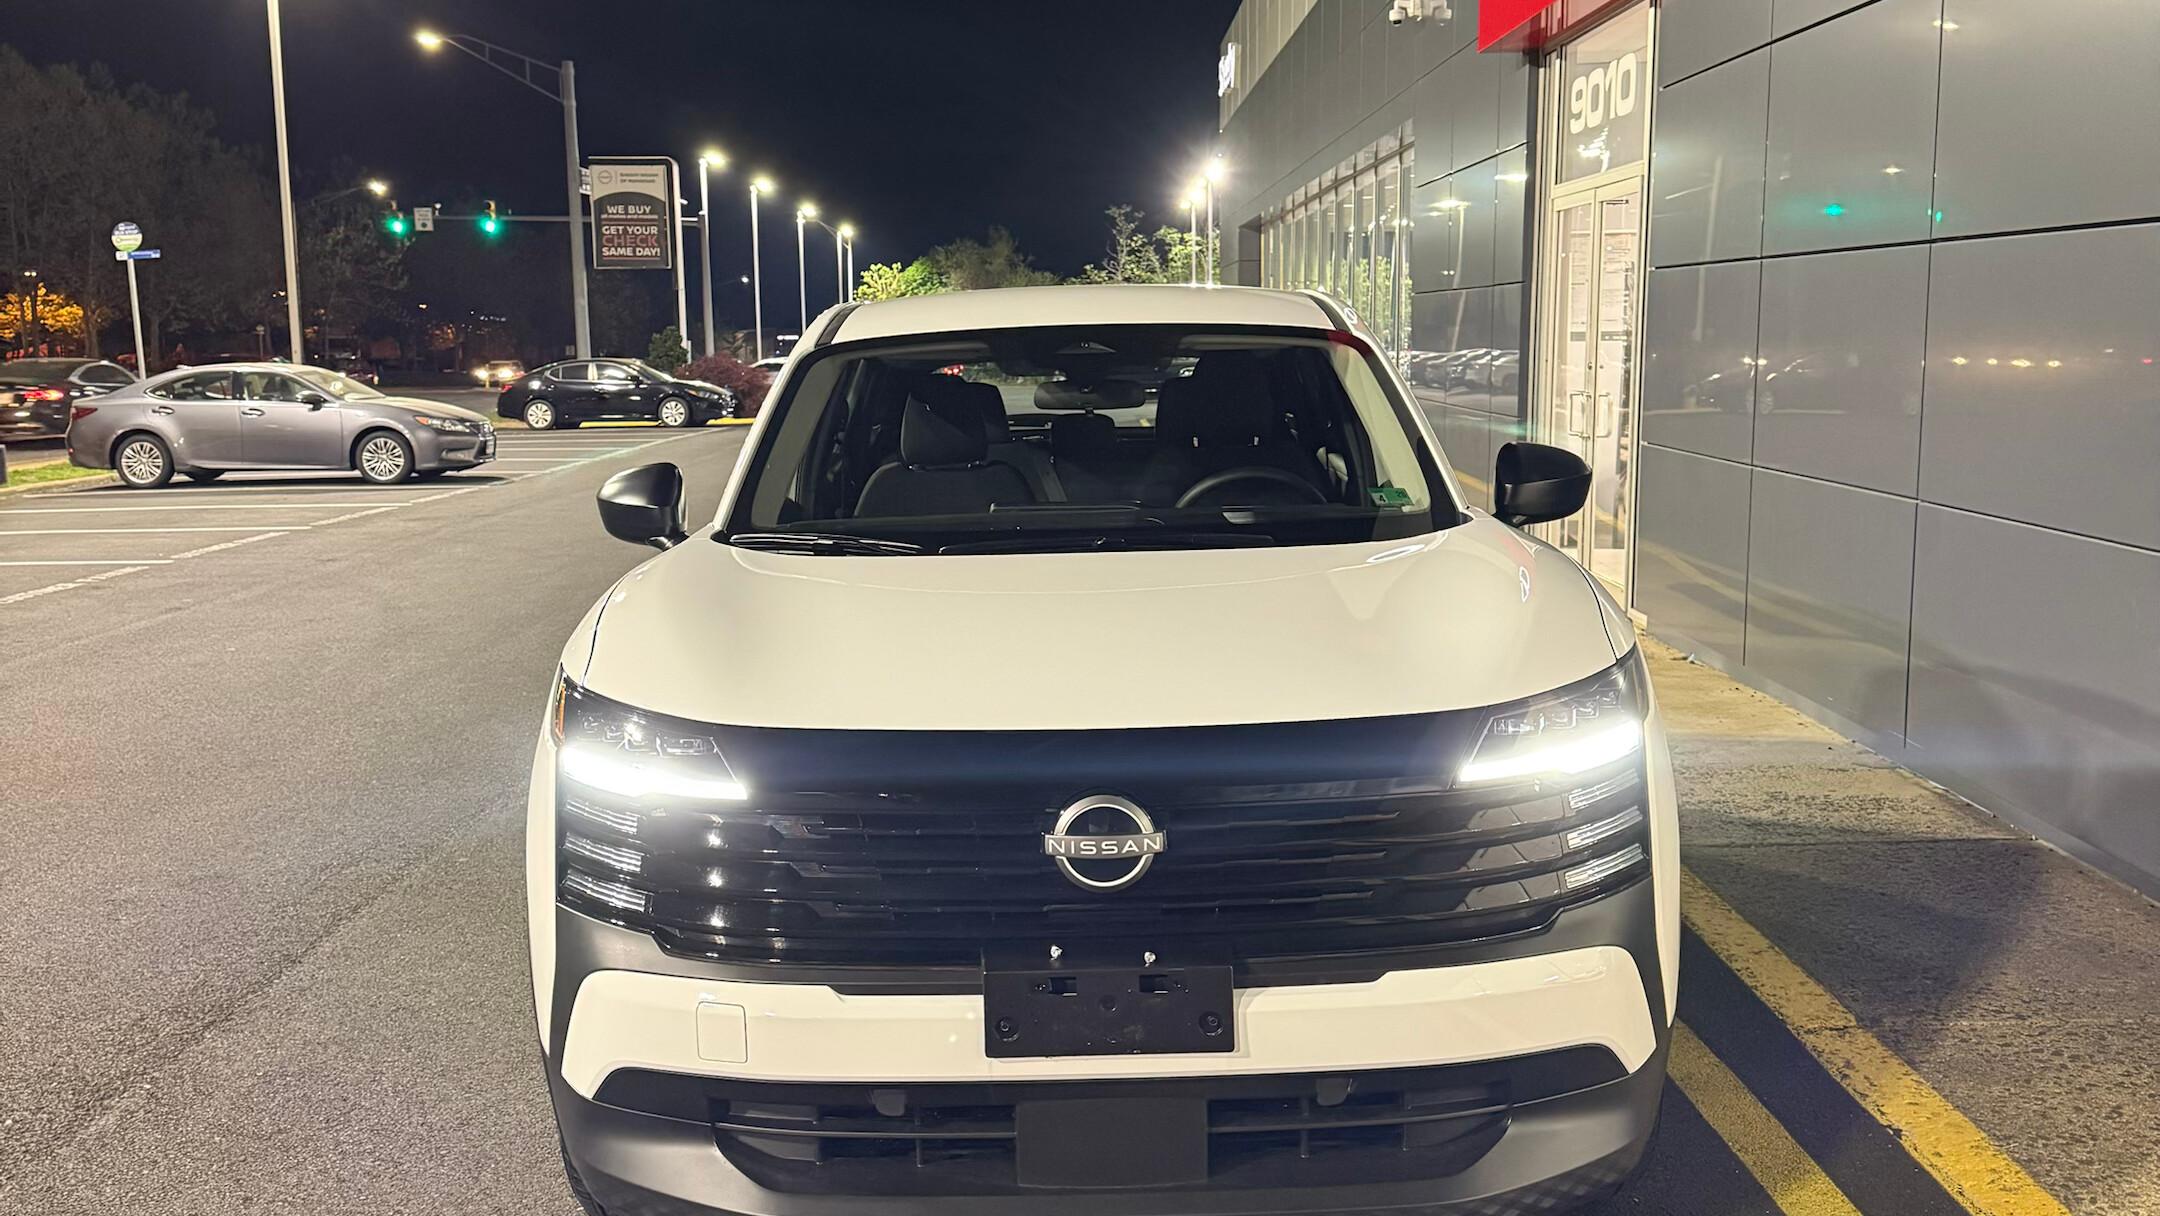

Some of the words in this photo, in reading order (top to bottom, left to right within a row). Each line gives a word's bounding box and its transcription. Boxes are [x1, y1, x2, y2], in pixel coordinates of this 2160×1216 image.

[1570, 53, 1636, 134] 9010
[607, 205, 625, 214] WE
[628, 205, 651, 214] BUY
[602, 226, 623, 235] GET
[626, 226, 658, 235] YOUR
[603, 235, 658, 247] CHECK
[602, 247, 633, 257] SAME
[635, 247, 660, 257] DAY!
[1048, 837, 1160, 855] NISSAN
